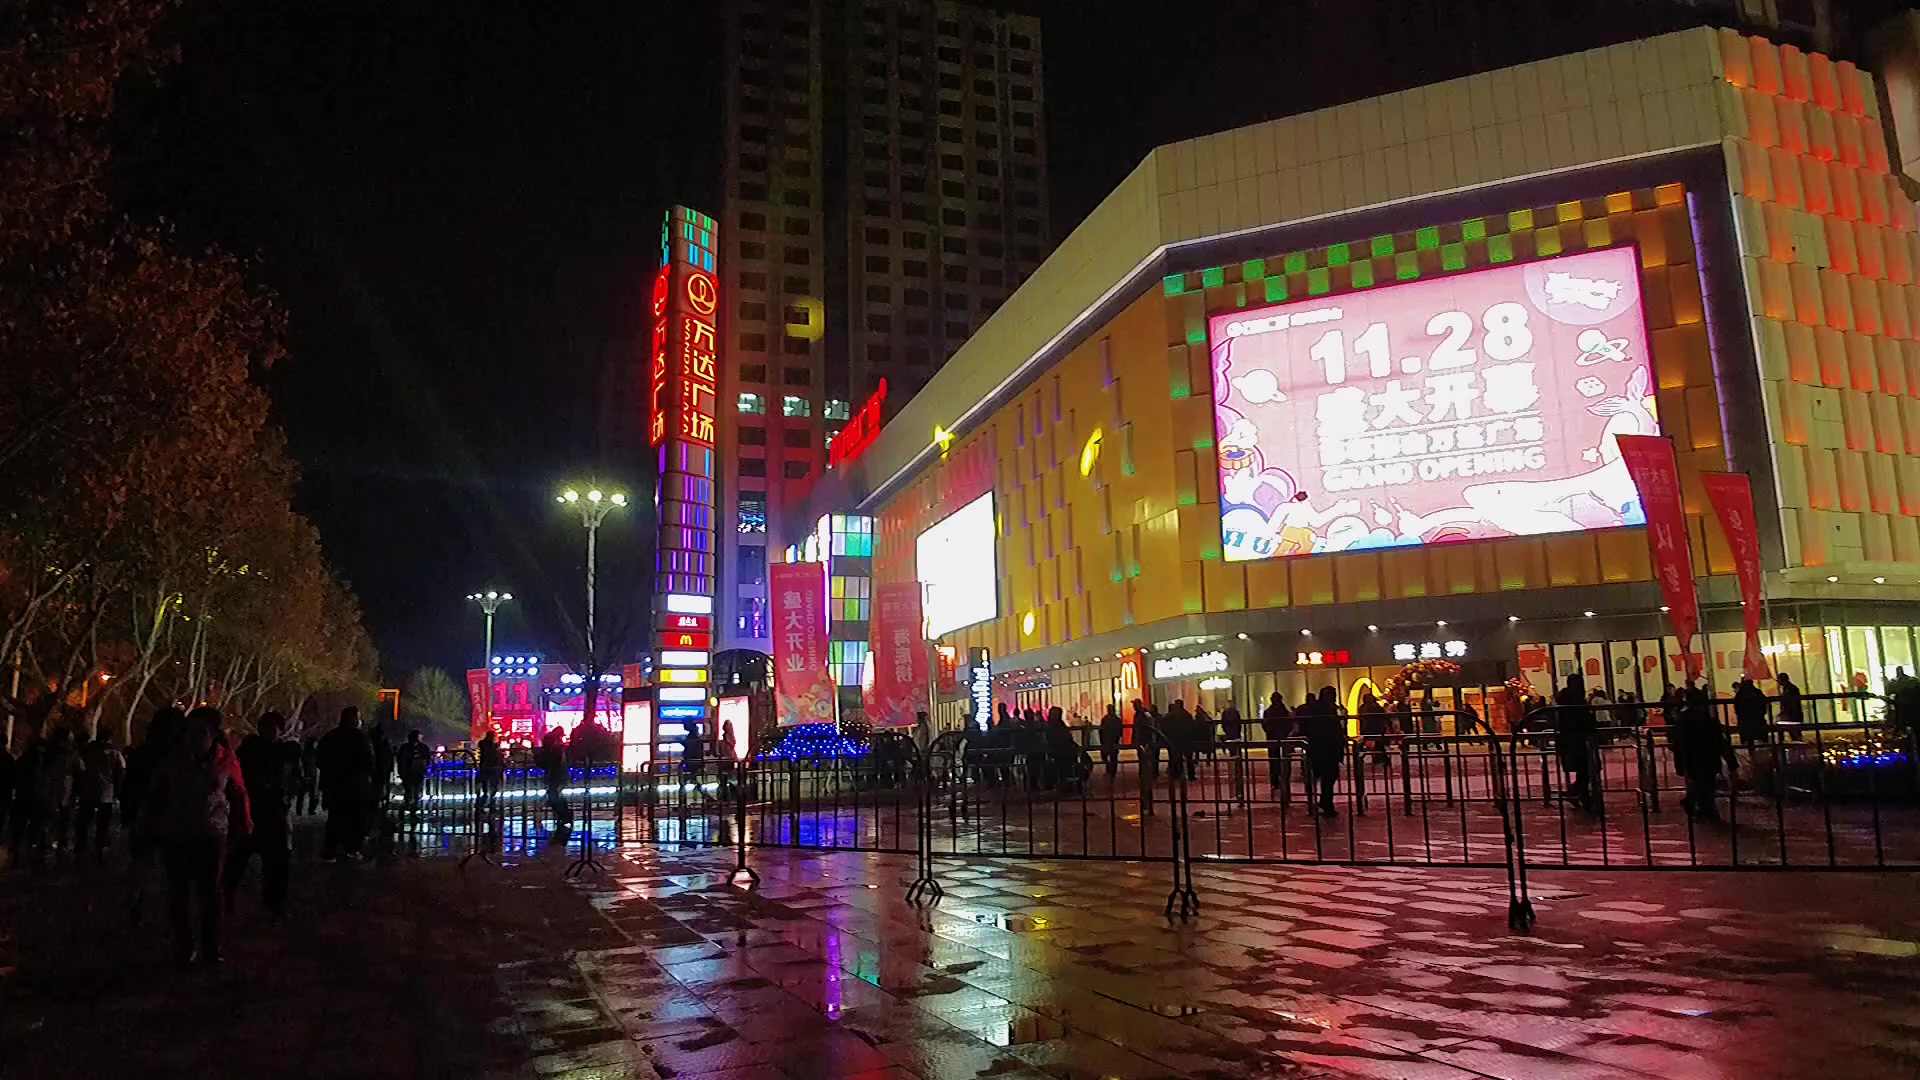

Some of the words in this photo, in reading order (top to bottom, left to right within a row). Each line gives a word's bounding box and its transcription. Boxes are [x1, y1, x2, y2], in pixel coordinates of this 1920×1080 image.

[691, 319, 716, 443] 万达广场
[1310, 302, 1533, 385] 11.28
[1322, 461, 1414, 493] GRAND
[1418, 446, 1547, 482] OPENING
